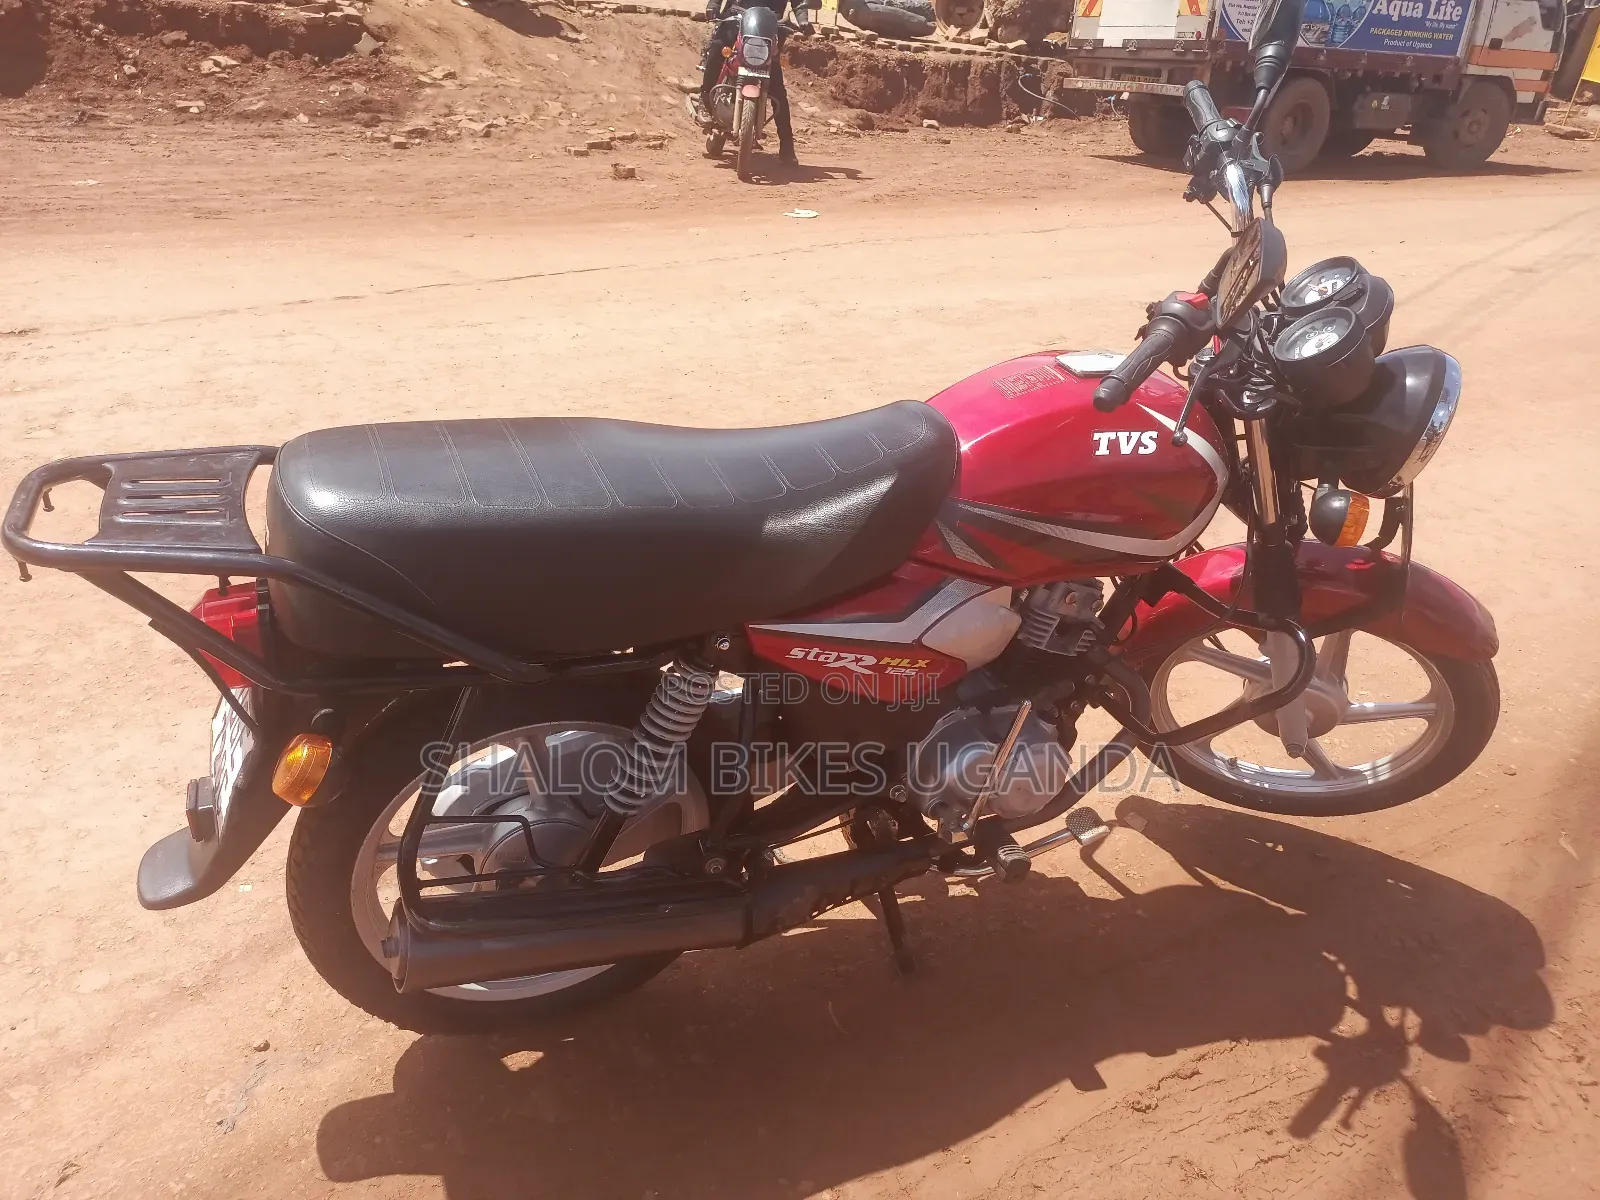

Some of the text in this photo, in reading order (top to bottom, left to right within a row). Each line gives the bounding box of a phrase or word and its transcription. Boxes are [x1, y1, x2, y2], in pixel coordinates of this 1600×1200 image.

[1372, 0, 1463, 21] Aqua Life
[1370, 27, 1454, 41] PACKAGED DRINKING WATER
[1383, 38, 1406, 47] Product
[1412, 41, 1433, 49] Uganda
[1092, 430, 1159, 456] TVS
[879, 656, 932, 668] HLX
[884, 667, 919, 676] 125
